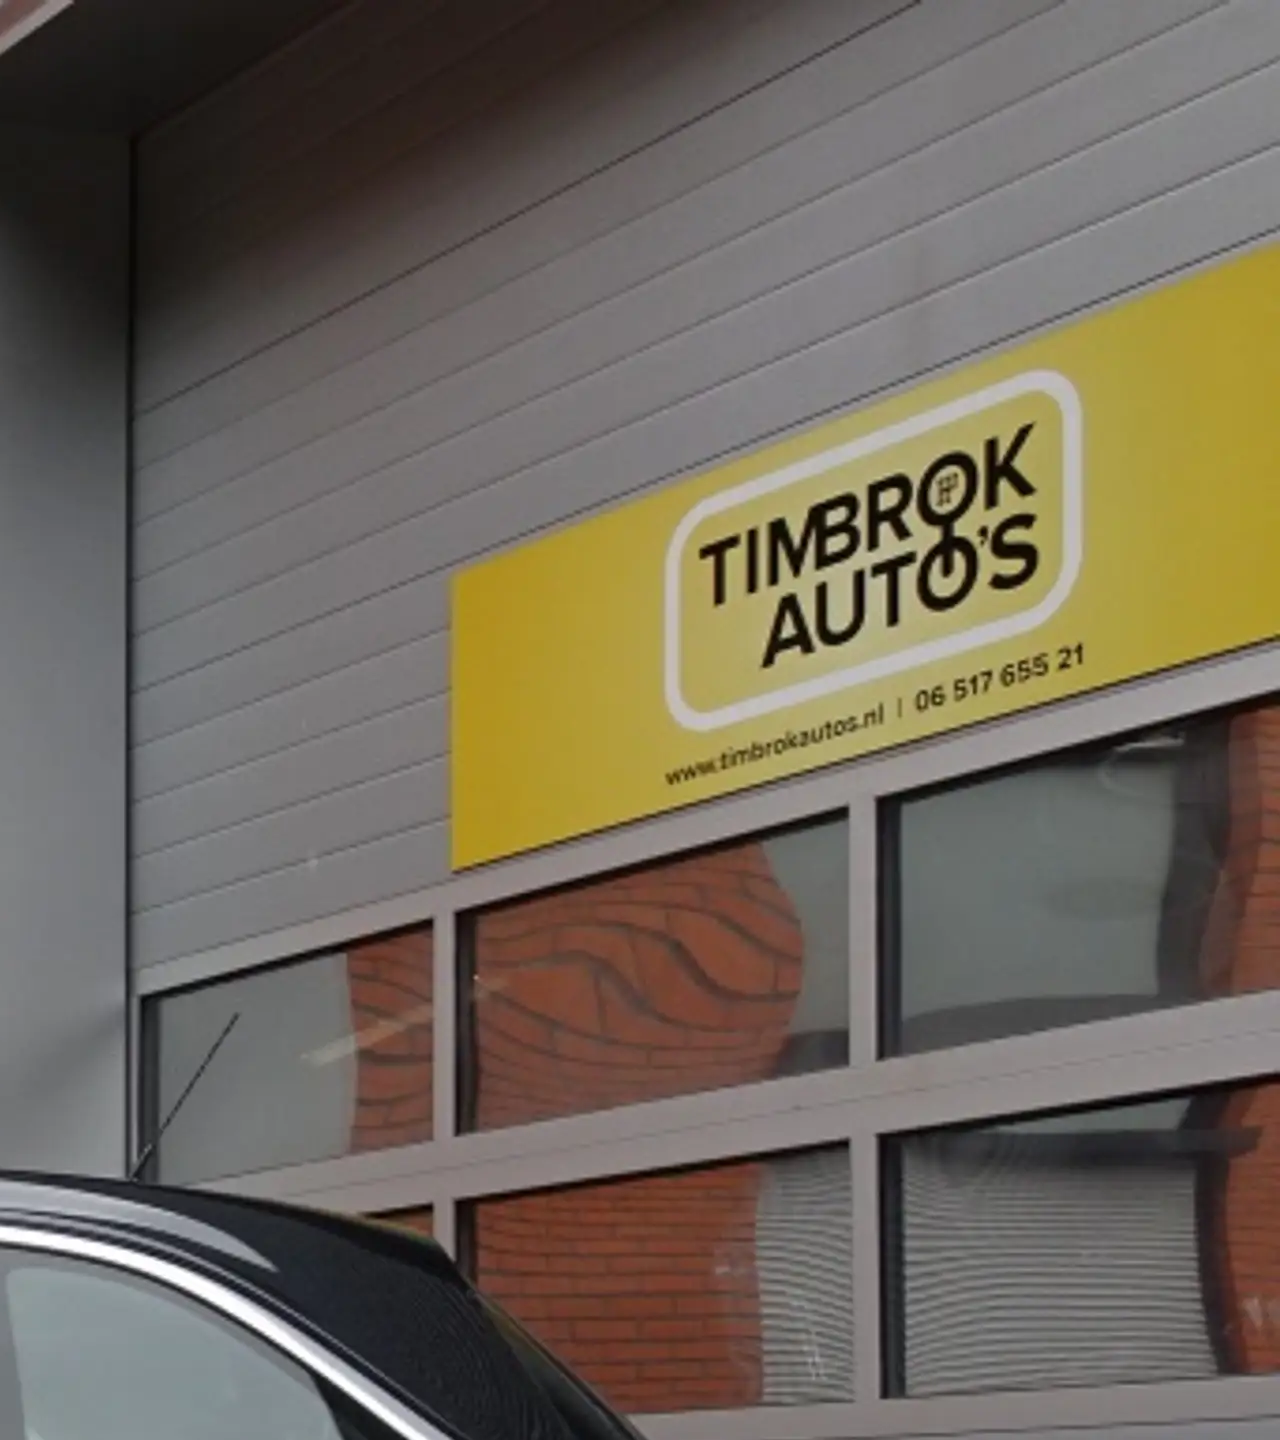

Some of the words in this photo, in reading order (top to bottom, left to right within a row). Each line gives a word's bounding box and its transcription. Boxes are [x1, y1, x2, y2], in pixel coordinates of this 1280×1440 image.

[698, 421, 1037, 607] TIMBROK
[760, 513, 1039, 669] AUTO'S
[664, 703, 885, 786] www.timbrokautos.nl
[914, 685, 947, 712] 06
[952, 671, 993, 702] 517
[1000, 653, 1049, 689] 655
[1057, 643, 1085, 671] 21
